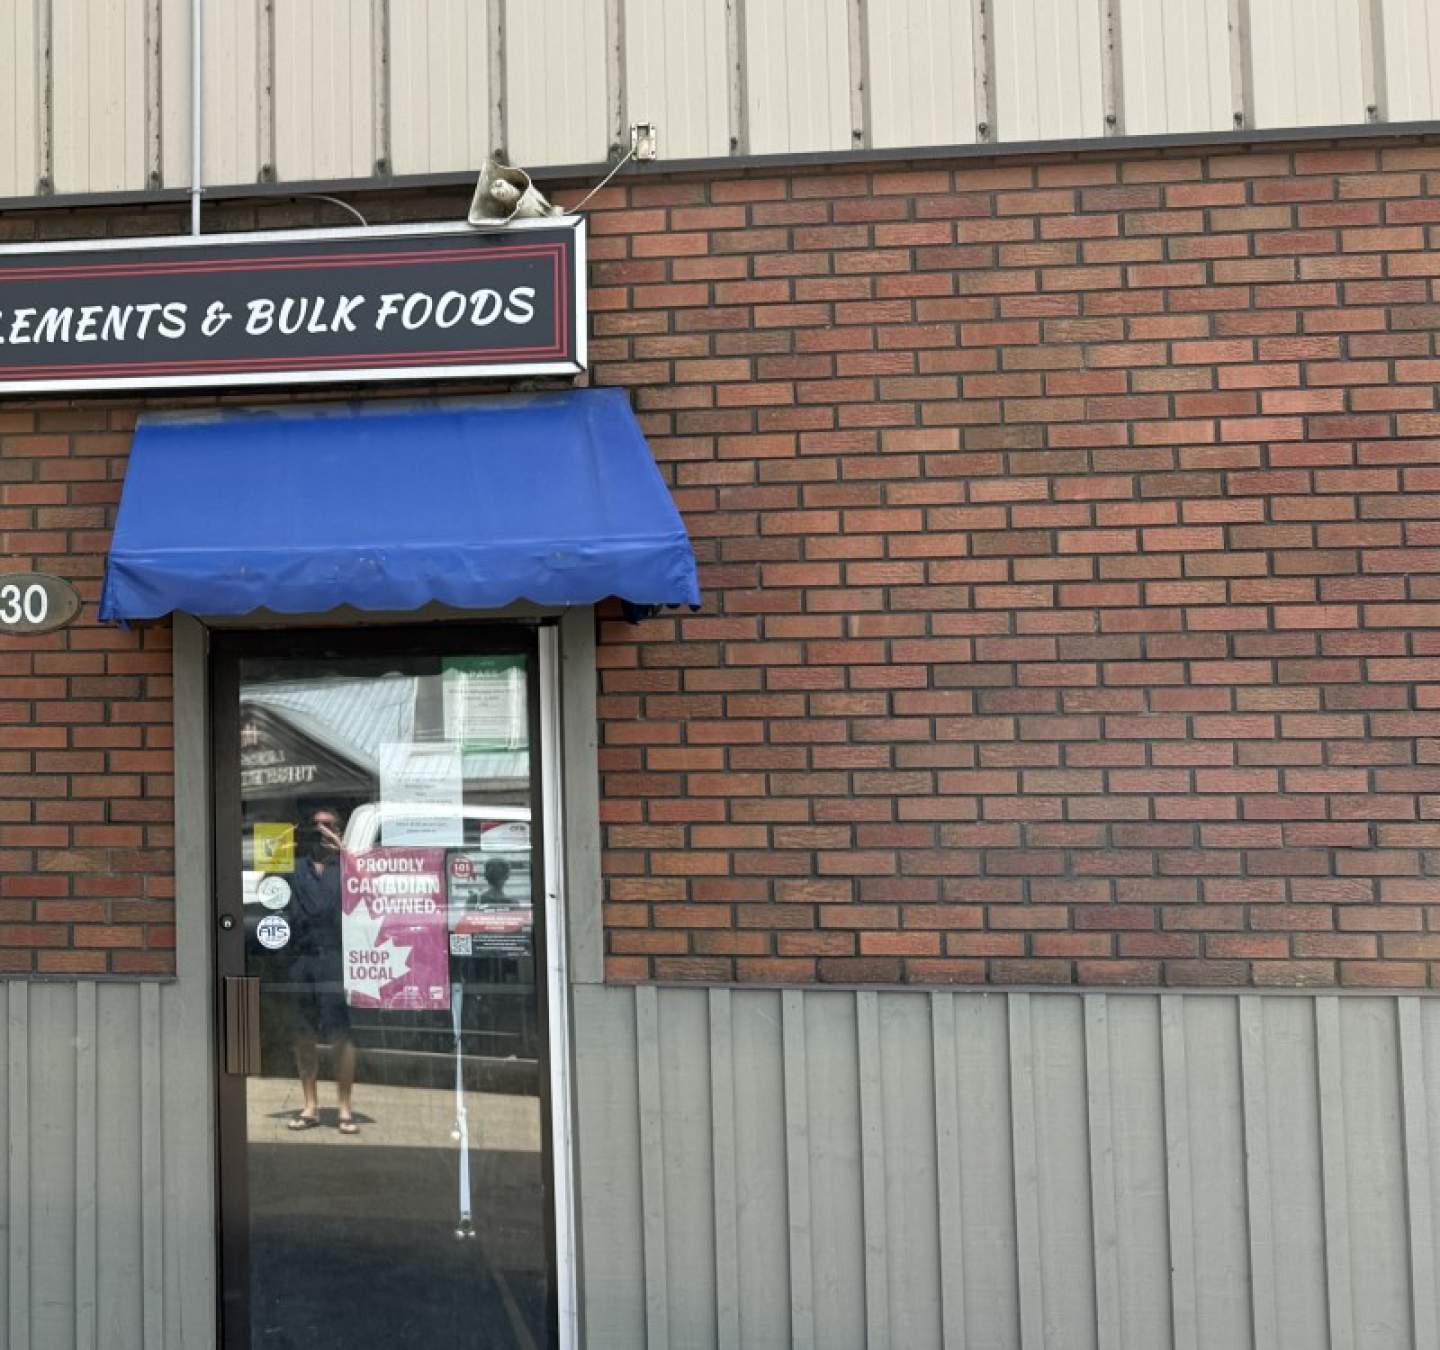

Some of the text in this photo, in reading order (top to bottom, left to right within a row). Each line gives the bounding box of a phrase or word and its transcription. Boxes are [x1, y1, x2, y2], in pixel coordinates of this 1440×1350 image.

[201, 300, 232, 335] &
[245, 294, 365, 335] BULK
[374, 286, 536, 331] FOODS
[0, 584, 48, 623] 30
[356, 858, 424, 872] PROUDLY
[347, 874, 440, 894] CANADIAN
[372, 897, 441, 914] OWNED.
[349, 950, 390, 964] SHOP
[350, 966, 393, 980] LOCAL
